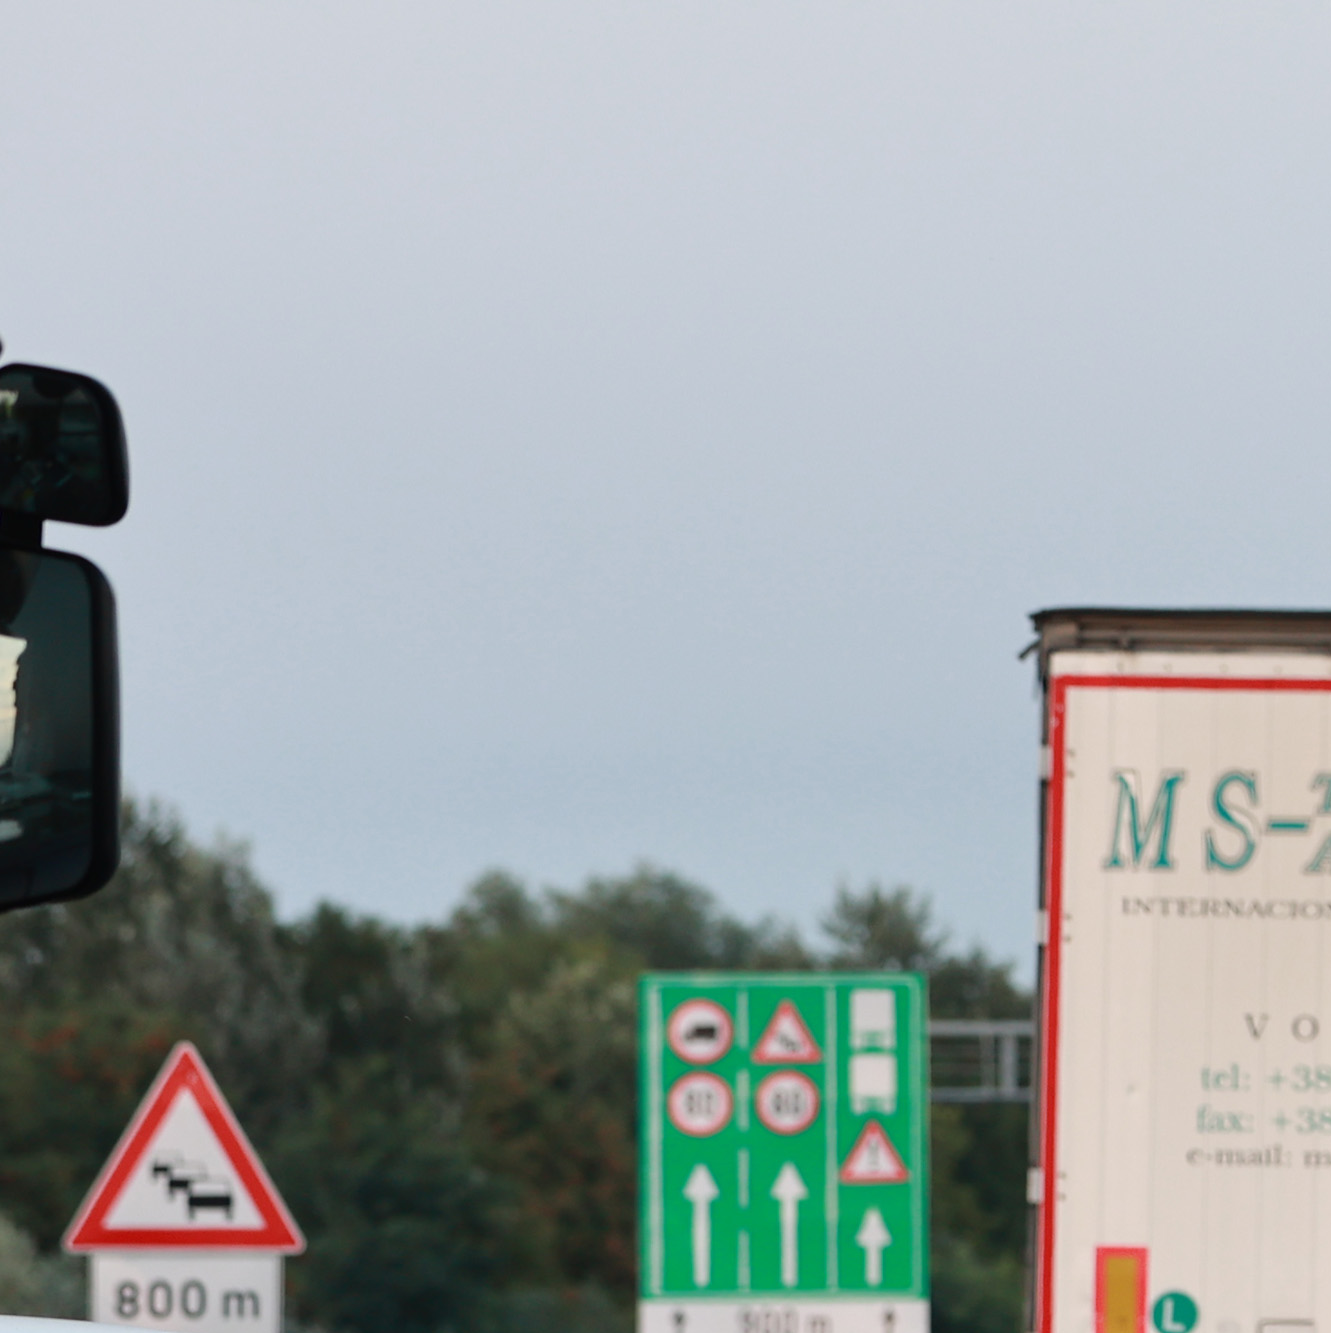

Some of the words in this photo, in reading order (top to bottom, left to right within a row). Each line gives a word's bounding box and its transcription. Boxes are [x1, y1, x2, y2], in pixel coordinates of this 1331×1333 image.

[1200, 1064, 1250, 1092] tel:
[1196, 1104, 1254, 1134] fax:
[1186, 1144, 1292, 1168] e-mail:
[117, 1280, 207, 1319] 800
[223, 1289, 260, 1317] m
[1161, 1297, 1187, 1333] L
